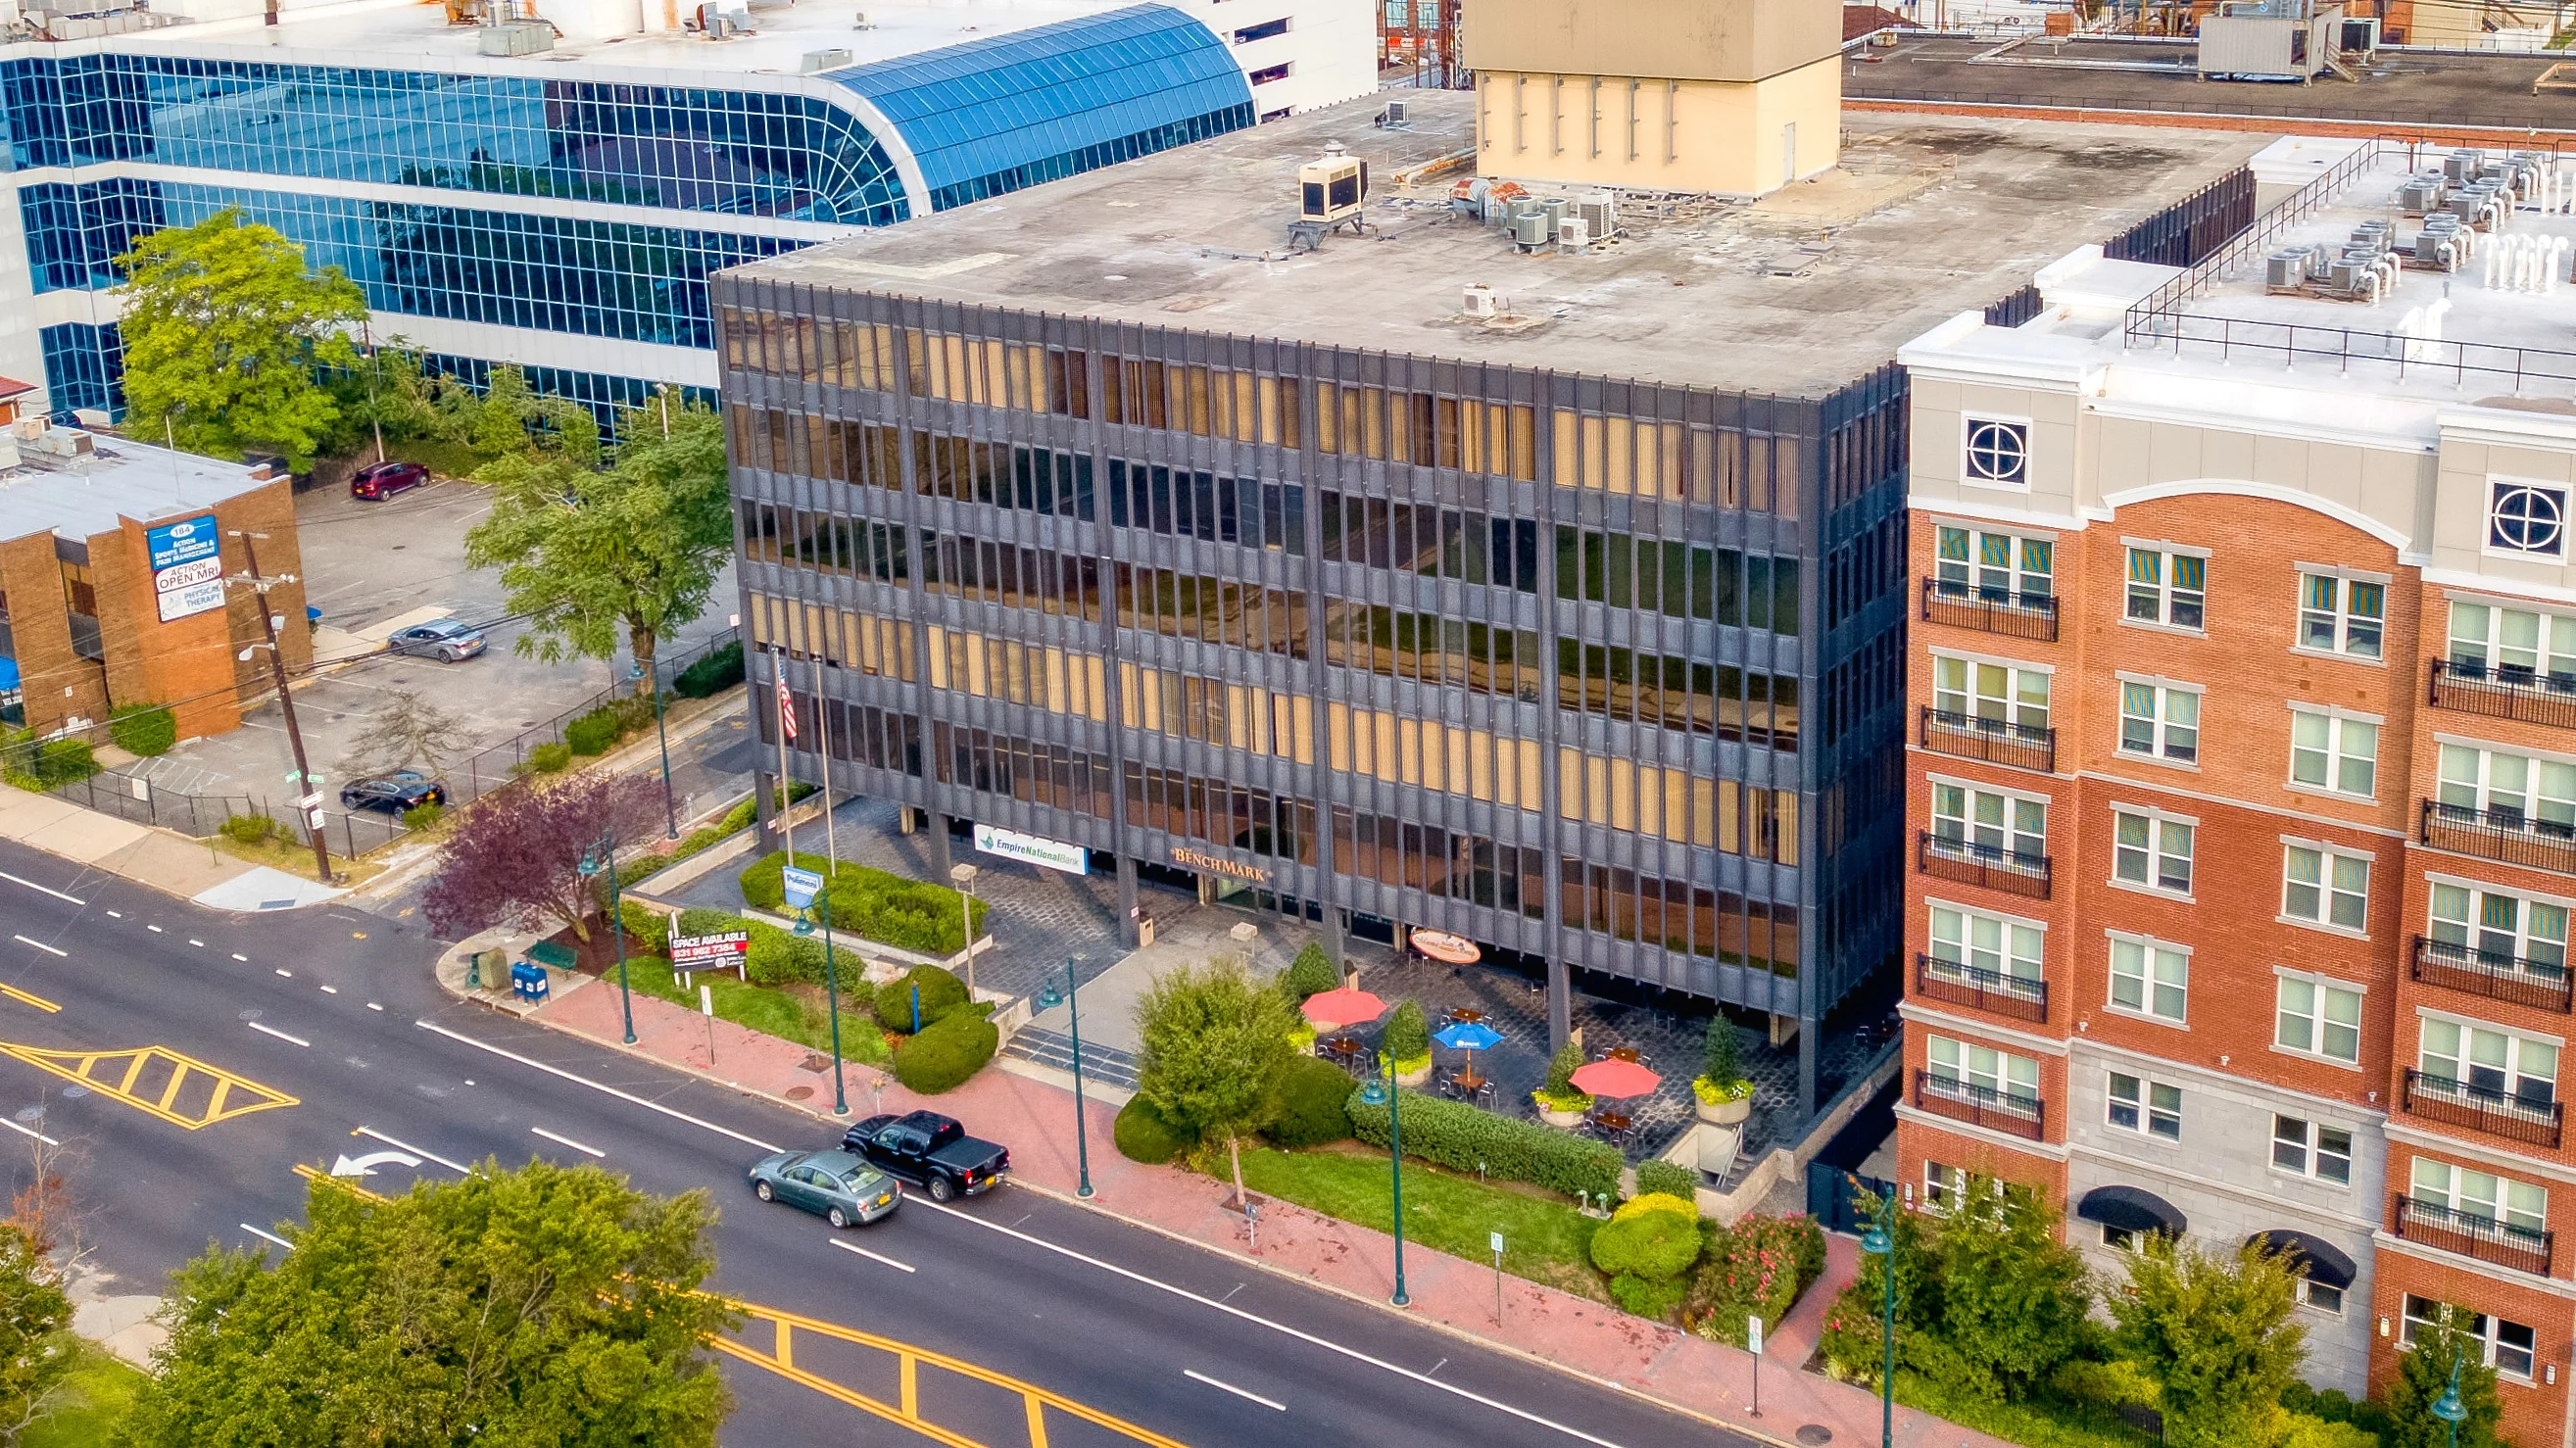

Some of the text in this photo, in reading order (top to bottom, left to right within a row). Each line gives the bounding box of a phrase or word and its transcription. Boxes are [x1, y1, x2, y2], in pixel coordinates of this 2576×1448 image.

[174, 526, 191, 536] 184
[171, 562, 207, 577] ACTION
[160, 566, 219, 589] OPEN MRI
[184, 585, 220, 600] PHYSICAL
[187, 595, 220, 607] THERAPY
[673, 932, 748, 948] SPACE AVAILABLE
